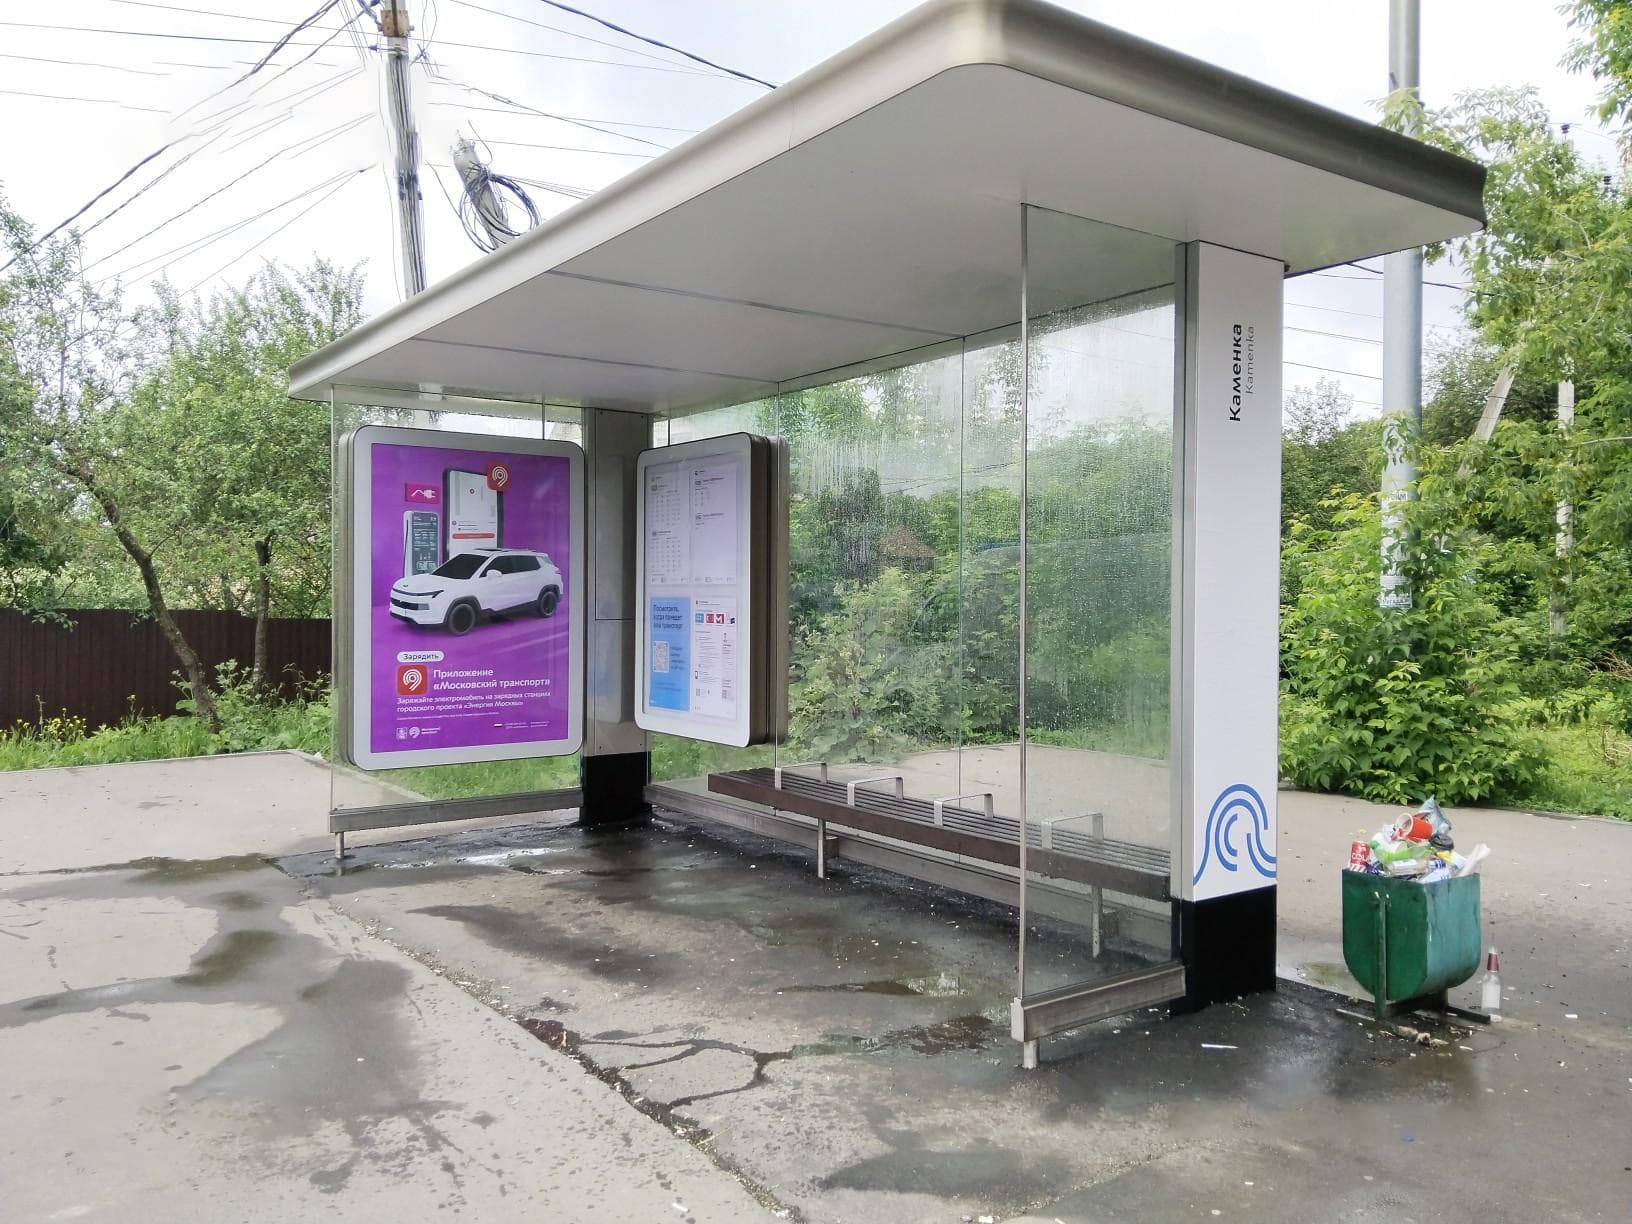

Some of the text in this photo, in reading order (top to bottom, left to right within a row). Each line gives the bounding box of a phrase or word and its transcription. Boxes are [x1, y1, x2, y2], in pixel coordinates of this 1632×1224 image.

[1246, 326, 1255, 394] Kamenka
[1230, 324, 1242, 421] Каменка
[402, 653, 439, 661] Зарядить
[433, 669, 494, 680] Приложение
[433, 679, 551, 691] «Московский транспорт»
[396, 704, 435, 713] городского
